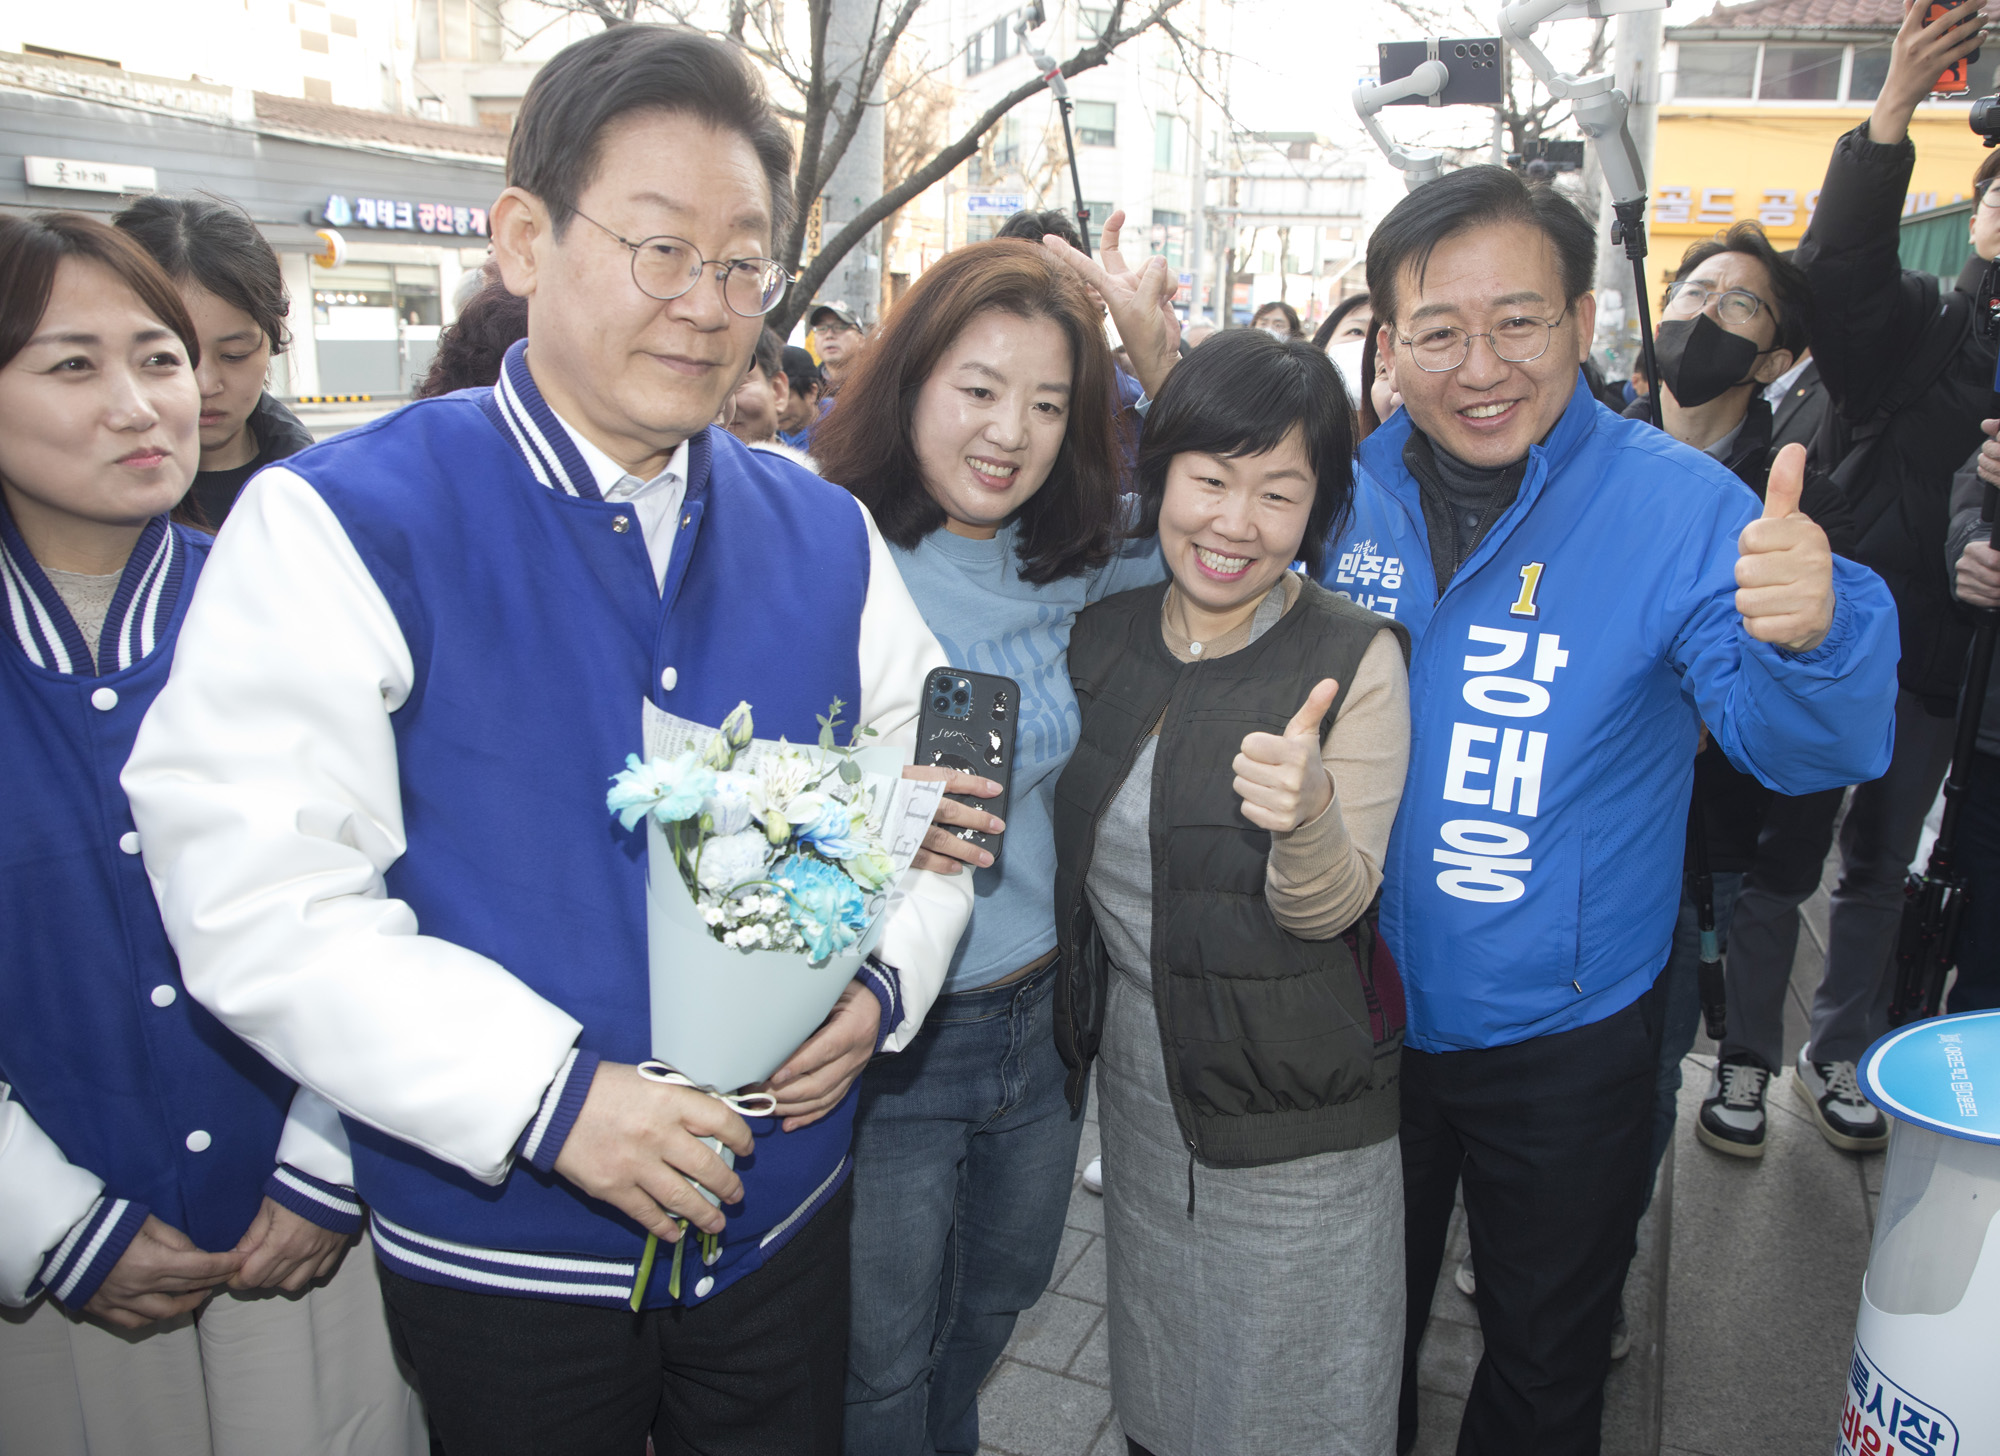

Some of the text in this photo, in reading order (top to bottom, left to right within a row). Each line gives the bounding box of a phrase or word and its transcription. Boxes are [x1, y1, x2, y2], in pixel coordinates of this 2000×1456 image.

[54, 161, 108, 184] 옷가게
[357, 197, 414, 229] 재테크
[1653, 186, 1735, 224] 골드
[1353, 539, 1379, 557] 더불어
[1336, 553, 1405, 590] 민주당
[1510, 561, 1547, 621] 1
[1433, 624, 1570, 904] 강태웅
[1848, 1344, 1946, 1456] 룩시장
